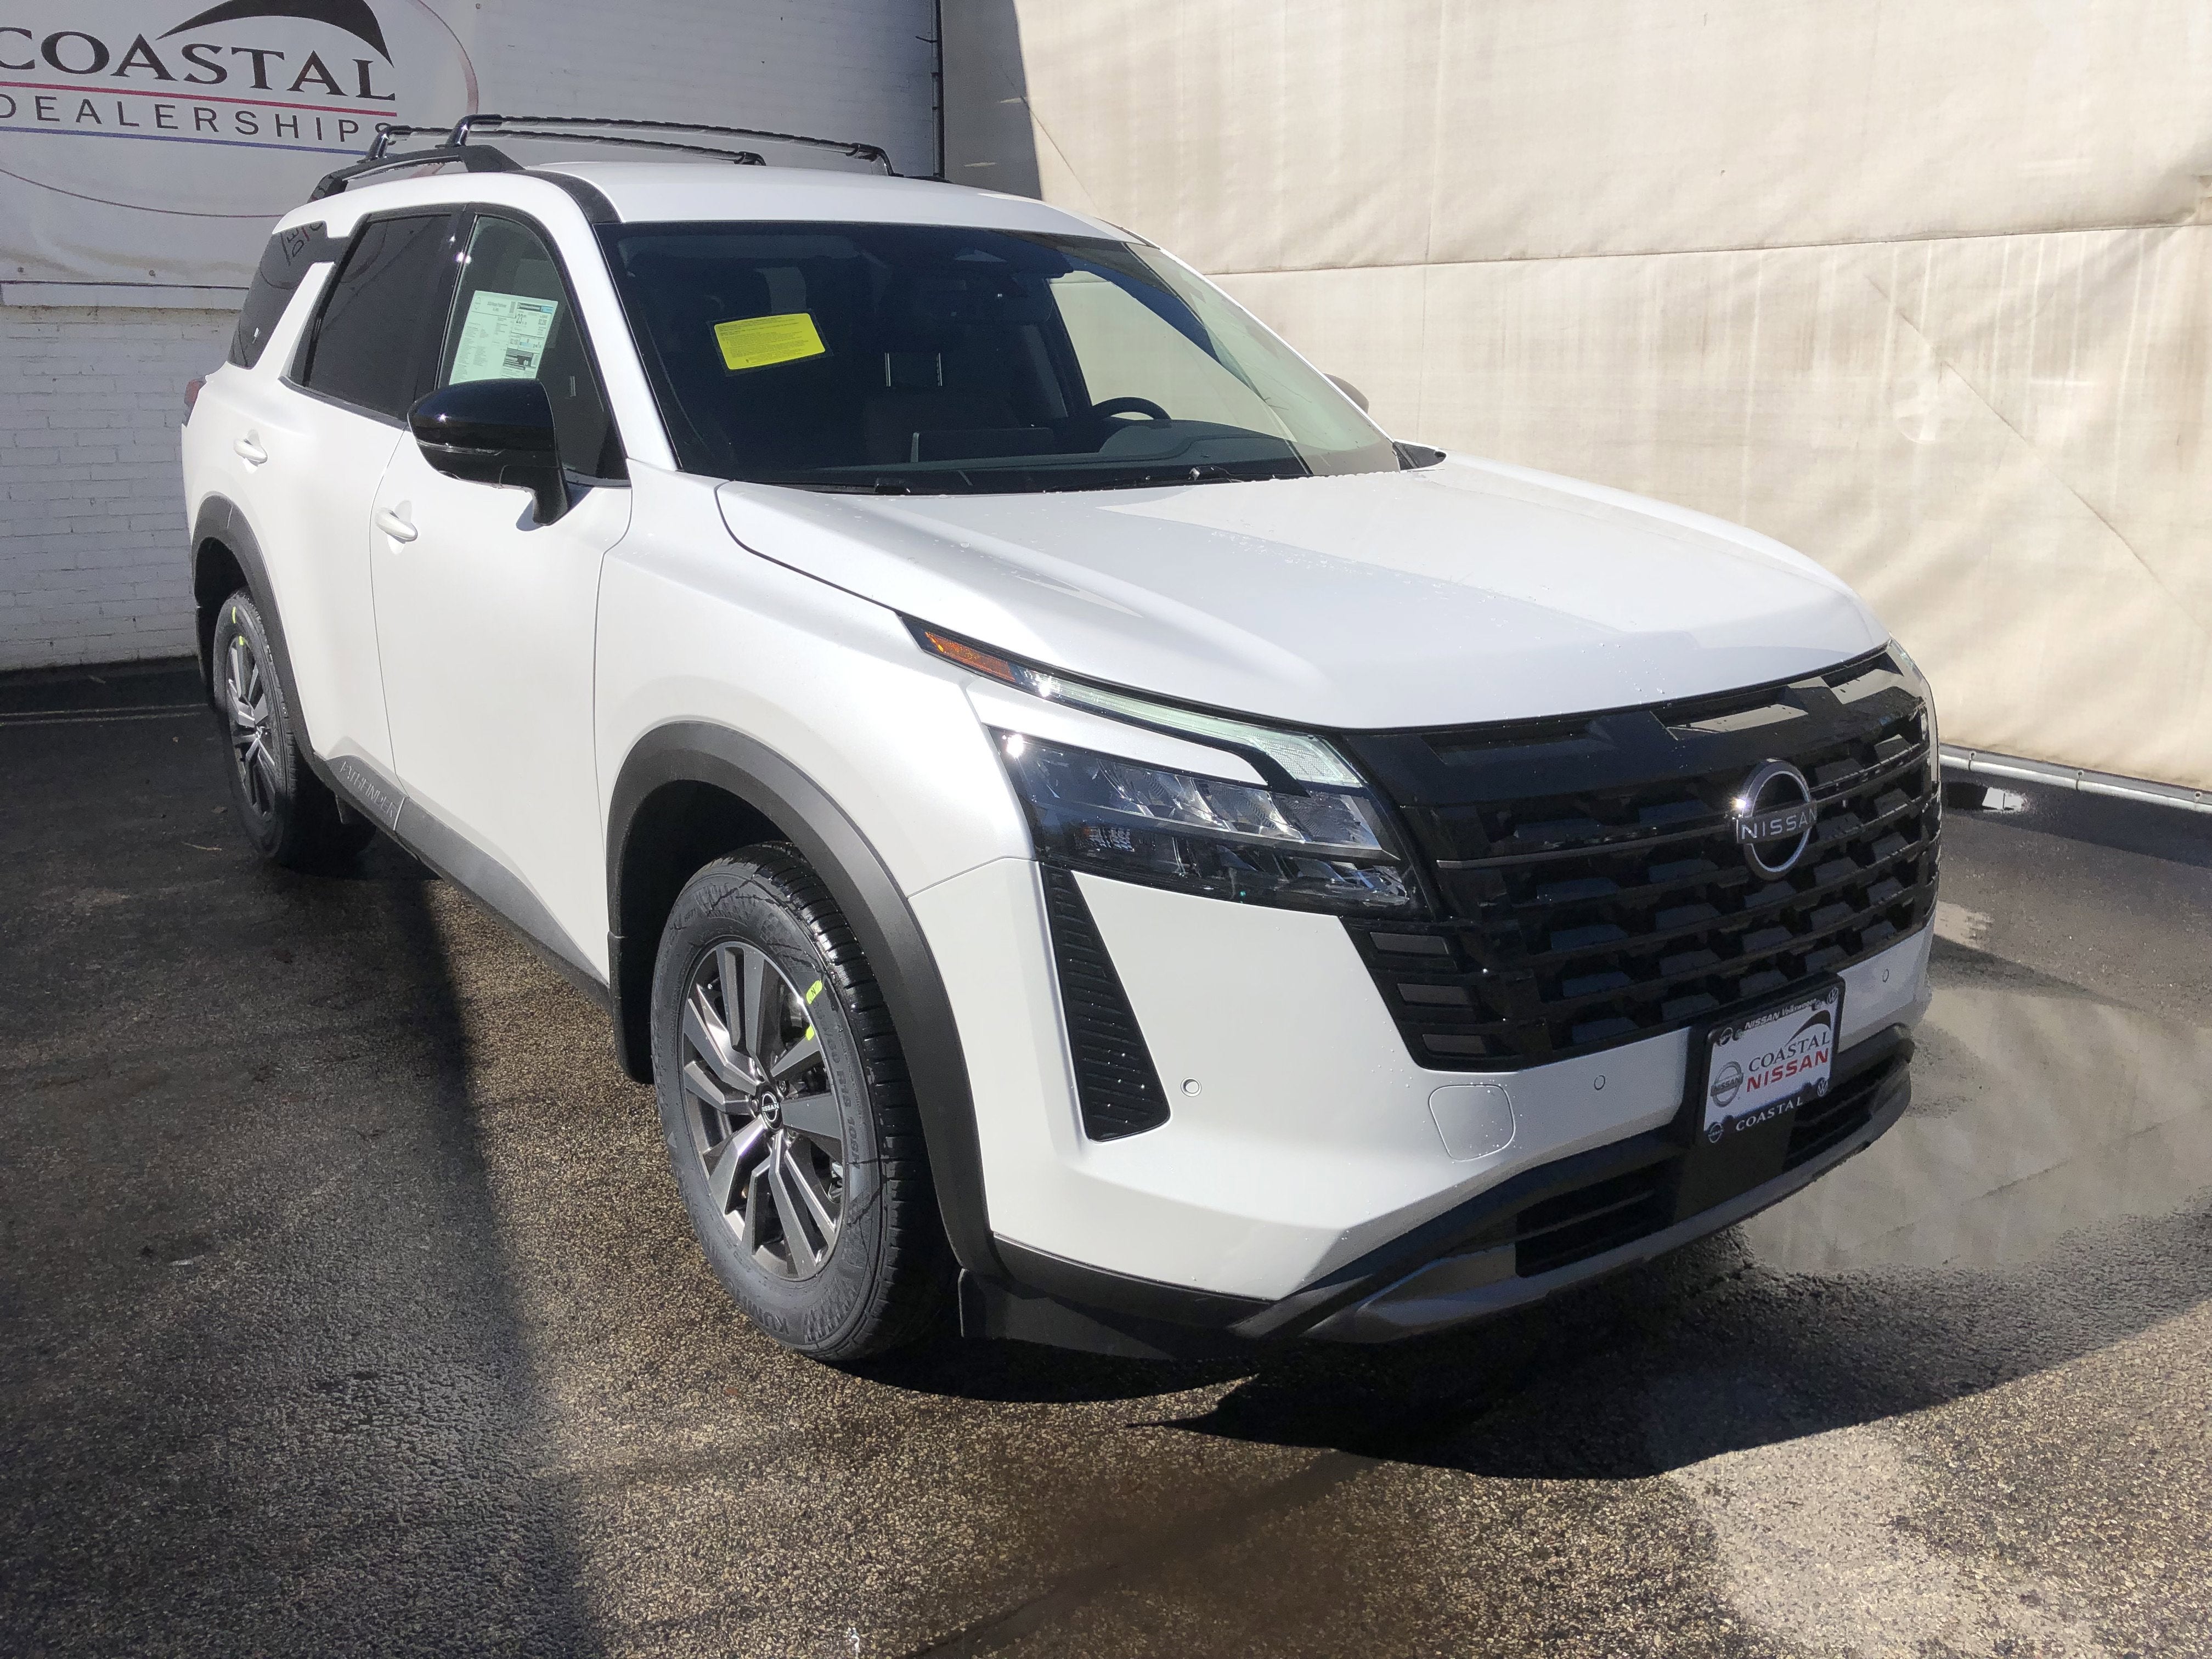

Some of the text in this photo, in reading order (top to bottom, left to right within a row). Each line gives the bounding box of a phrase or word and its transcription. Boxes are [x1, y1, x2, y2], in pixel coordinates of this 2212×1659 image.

[0, 27, 396, 100] COASTAL
[1741, 809, 1817, 839] NISSAN
[1745, 1011, 1779, 1030] NISSAN
[1748, 1031, 1830, 1072] COASTAL
[1713, 1076, 1742, 1093] NISSAN
[1746, 1048, 1829, 1092] NISSAN
[1736, 1096, 1803, 1131] COASTAL
